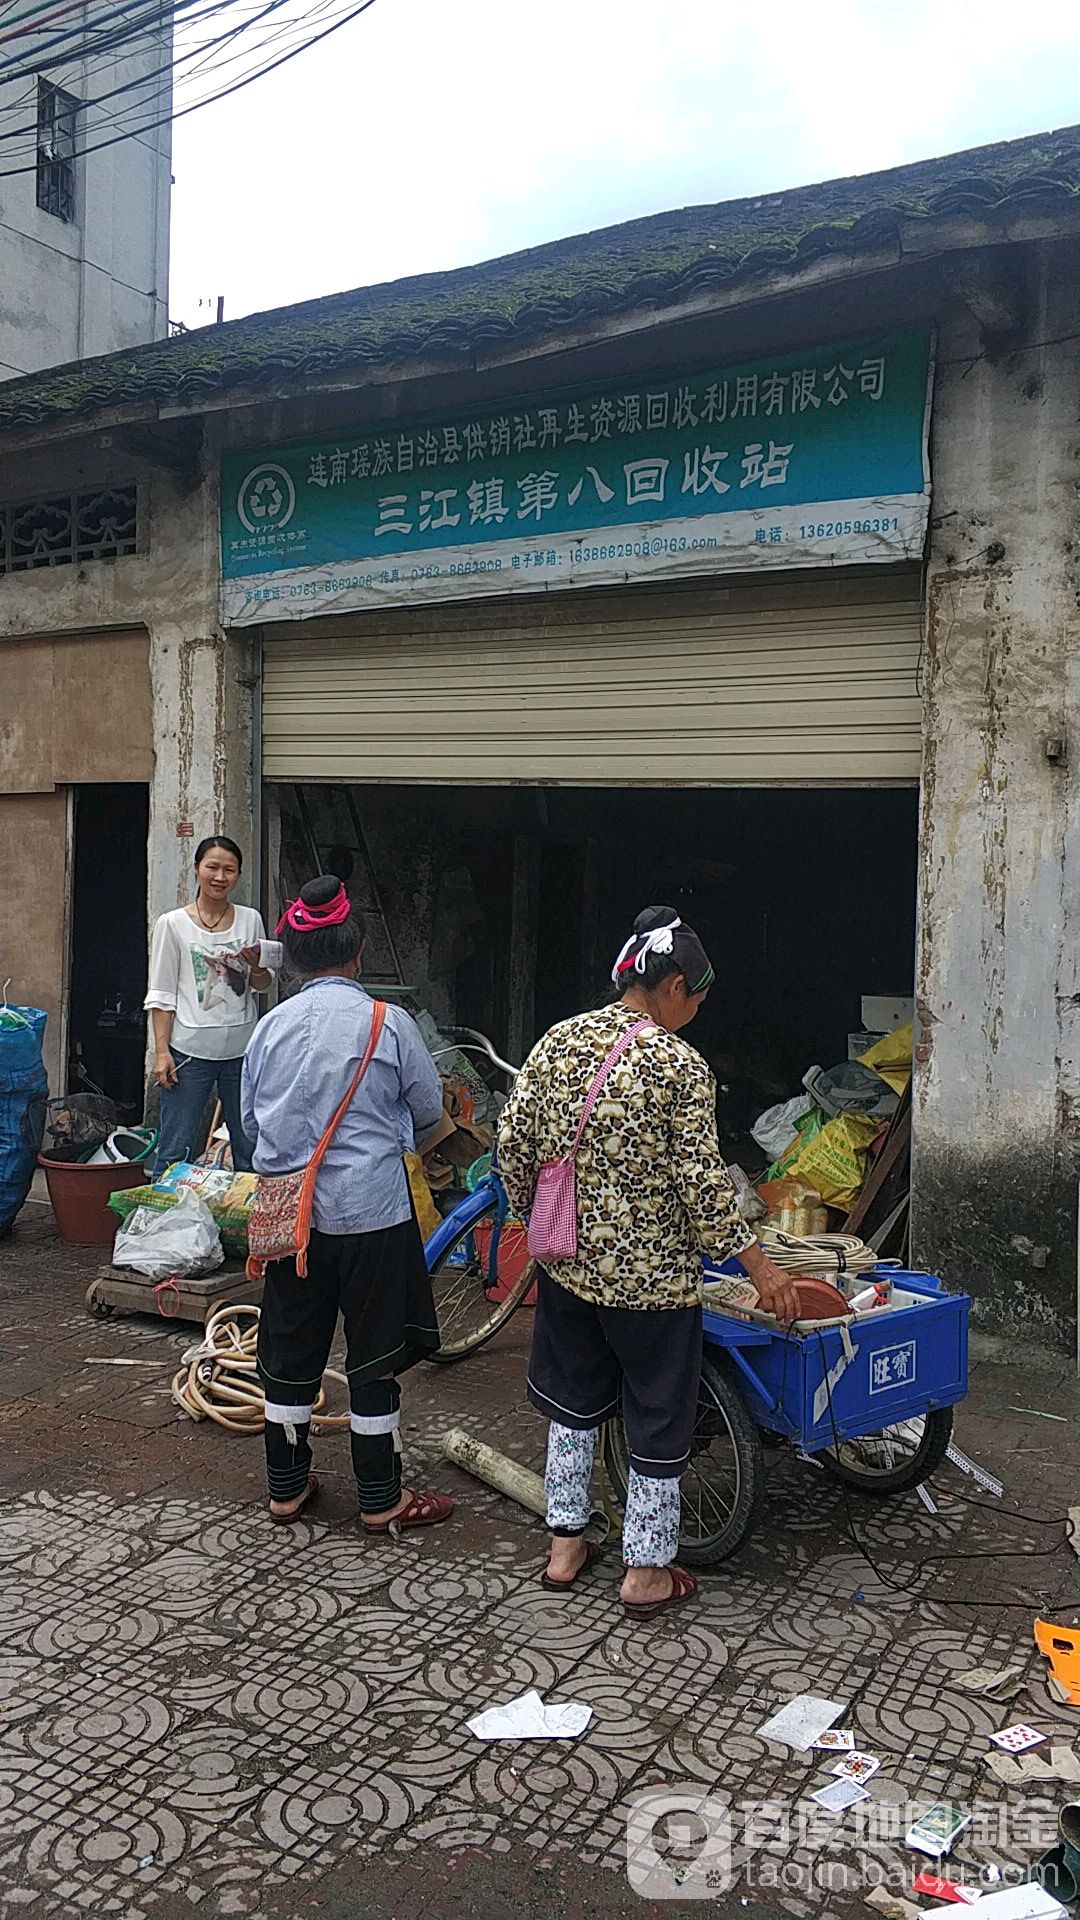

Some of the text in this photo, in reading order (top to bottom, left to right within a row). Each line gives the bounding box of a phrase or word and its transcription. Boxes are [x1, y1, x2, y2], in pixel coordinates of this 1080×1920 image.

[307, 357, 885, 488] 连南瑶族自治县供销社再生资源回收利用有限公司
[374, 441, 794, 536] 三江镇第八回收站
